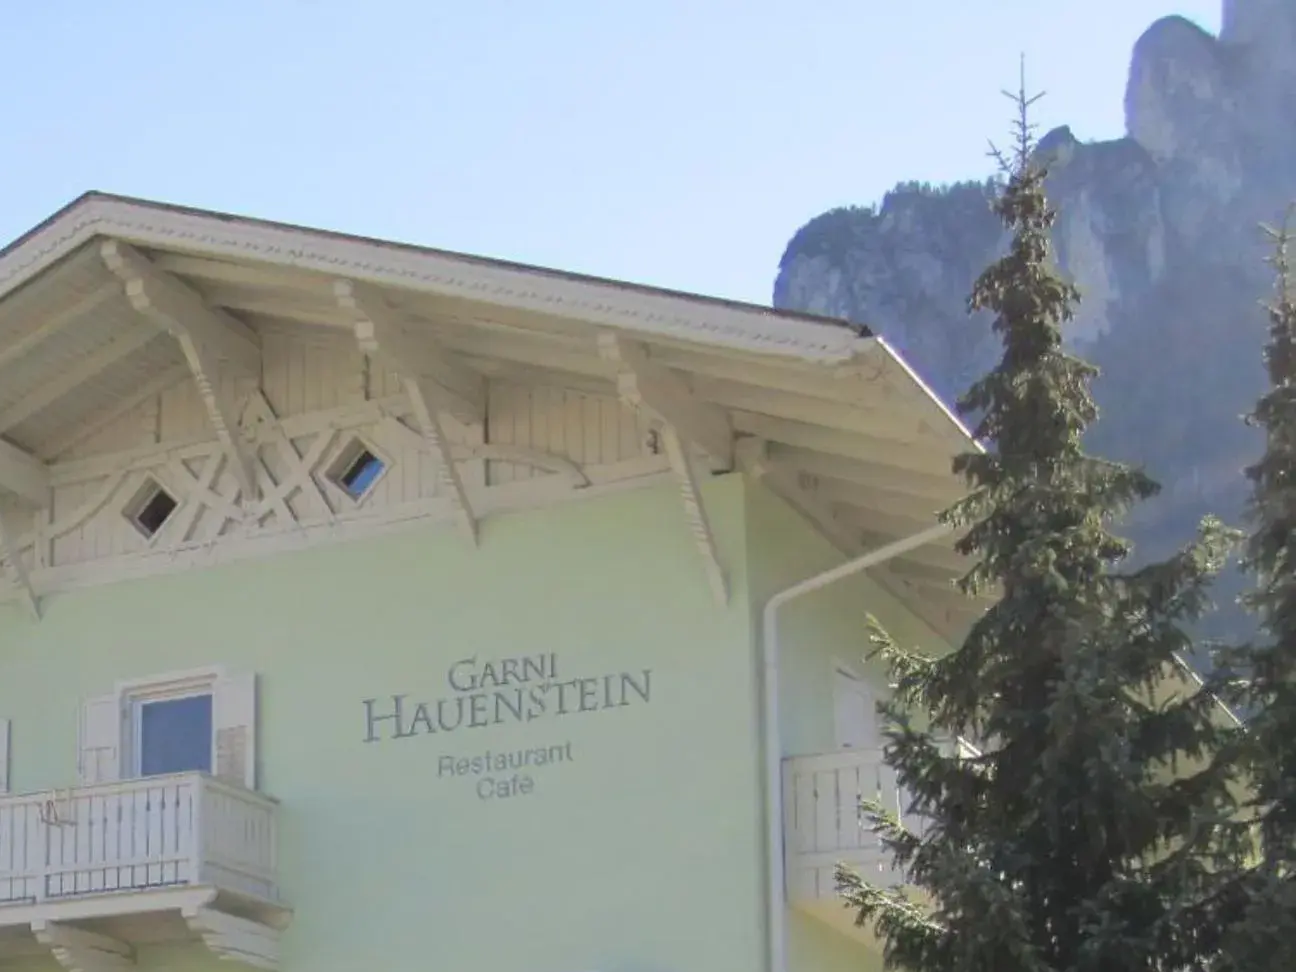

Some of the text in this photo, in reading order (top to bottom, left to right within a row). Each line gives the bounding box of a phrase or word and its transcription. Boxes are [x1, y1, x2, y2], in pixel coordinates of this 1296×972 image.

[448, 652, 559, 693] GARNI
[362, 669, 653, 743] HAUENSTEIN
[437, 740, 574, 778] Restaurant
